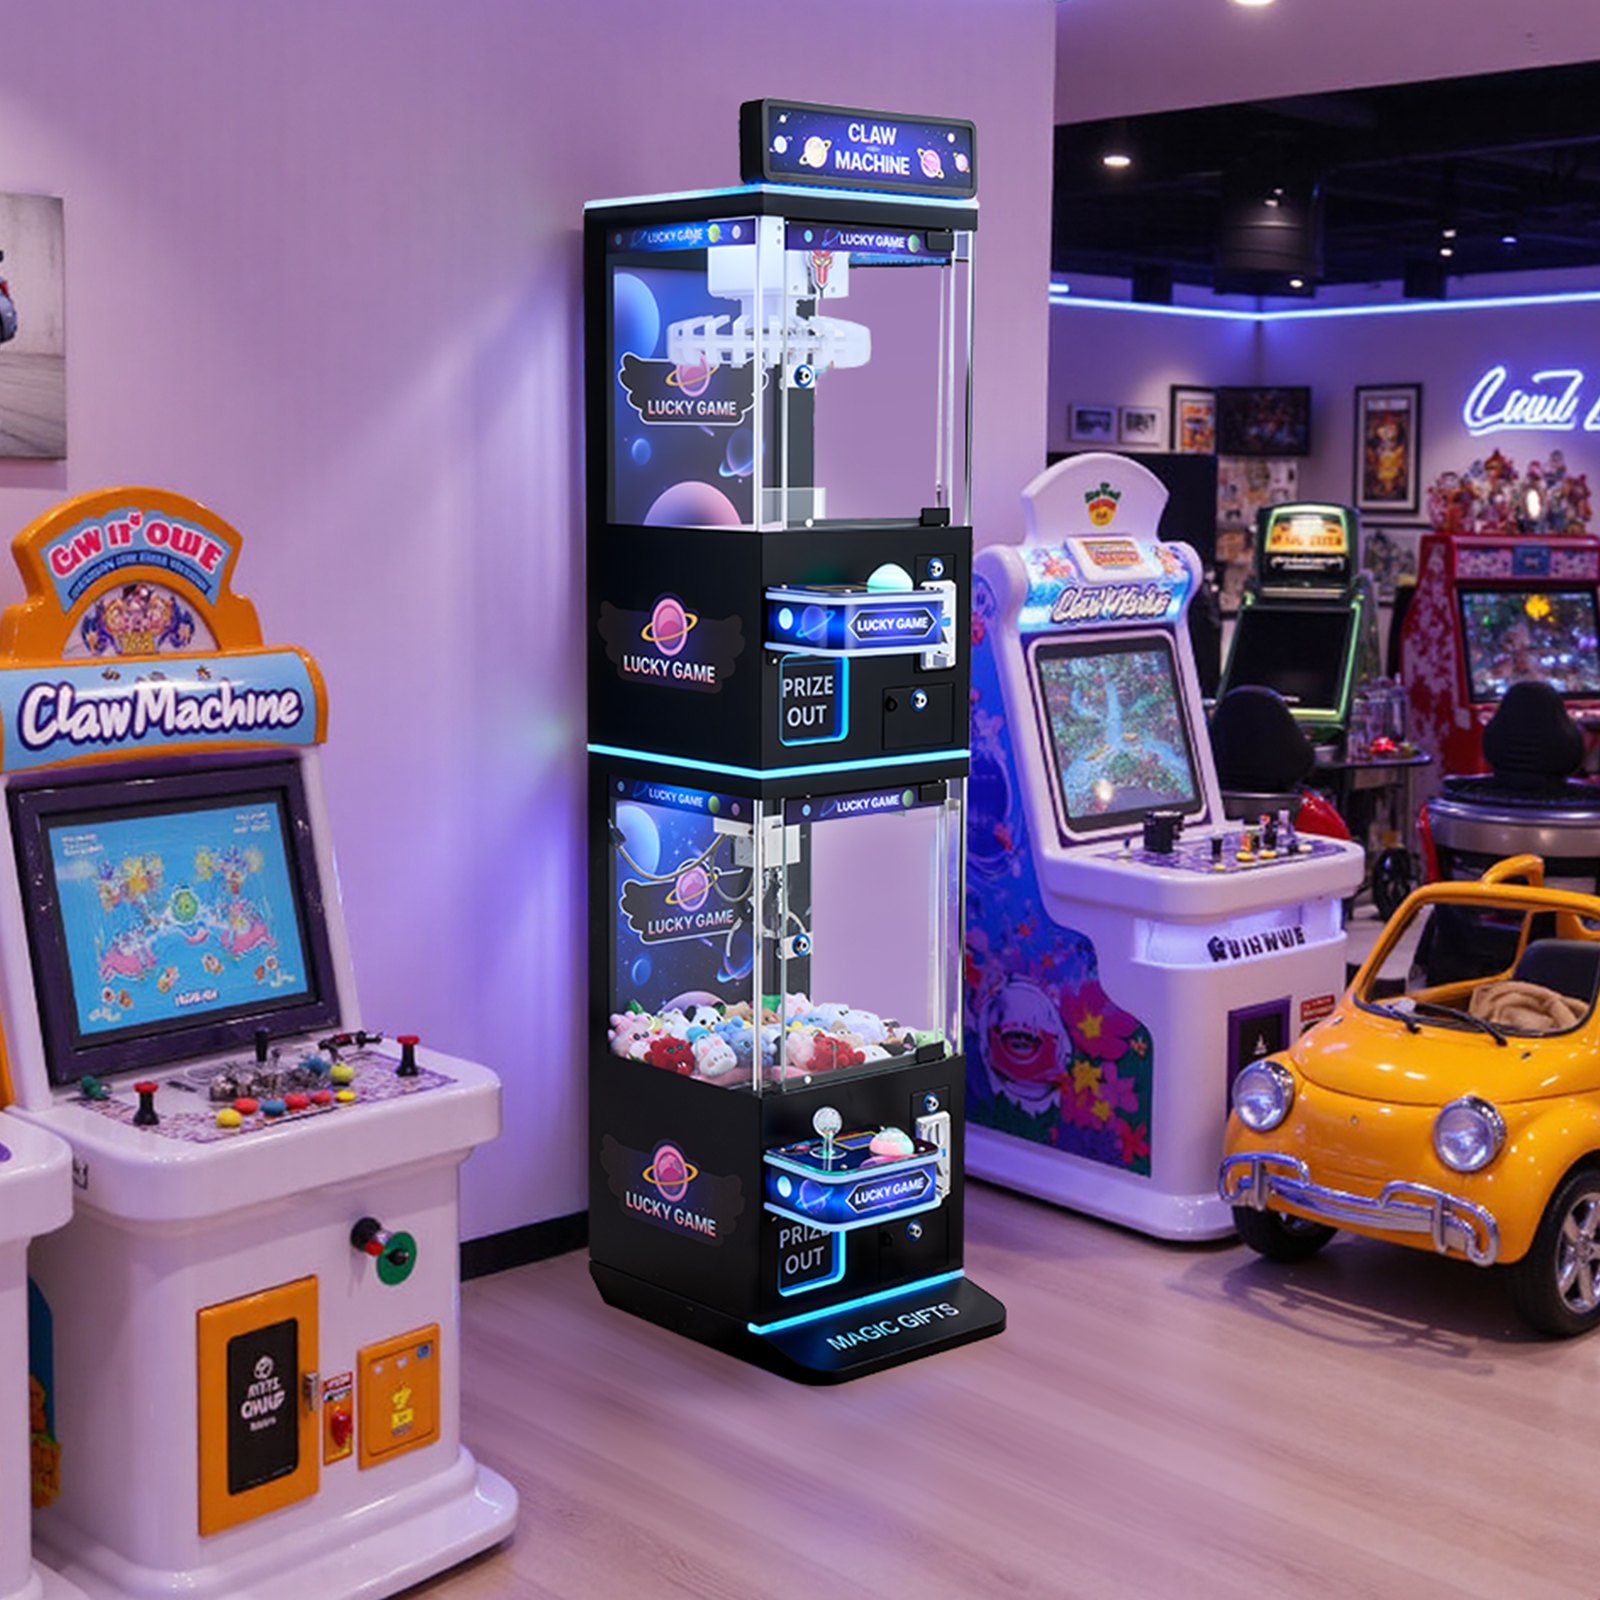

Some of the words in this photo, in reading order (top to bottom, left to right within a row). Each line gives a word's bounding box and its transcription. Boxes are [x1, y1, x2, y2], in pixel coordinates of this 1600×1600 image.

[848, 122, 897, 146] CLAW
[834, 150, 911, 176] MACHINE
[647, 230, 676, 244] LUCKY
[677, 228, 703, 241] GAME
[840, 233, 874, 247] LUCKY
[875, 235, 905, 248] GAME
[647, 400, 694, 415] LUCKY
[696, 401, 737, 416] GAME
[857, 618, 895, 632] LUCKY
[896, 617, 929, 630] GAME
[623, 654, 671, 677] LUCKY
[672, 661, 716, 684] GAME
[782, 675, 834, 698] PRIZE
[786, 705, 828, 727] OUT
[649, 787, 677, 802] LUCKY
[678, 792, 704, 808] GAME
[836, 798, 871, 814] LUCKY
[871, 794, 900, 809] GAME
[648, 916, 693, 936] LUCKY
[695, 909, 734, 928] GAME
[855, 1185, 891, 1205] LUCKY
[892, 1177, 925, 1195] GAME
[625, 1191, 672, 1222] LUCKY
[673, 1208, 718, 1237] GAME
[779, 1223, 831, 1249] PRIZ
[784, 1246, 825, 1275] OUT
[826, 1320, 901, 1351] MAGIC
[897, 1302, 960, 1328] GIFTS
